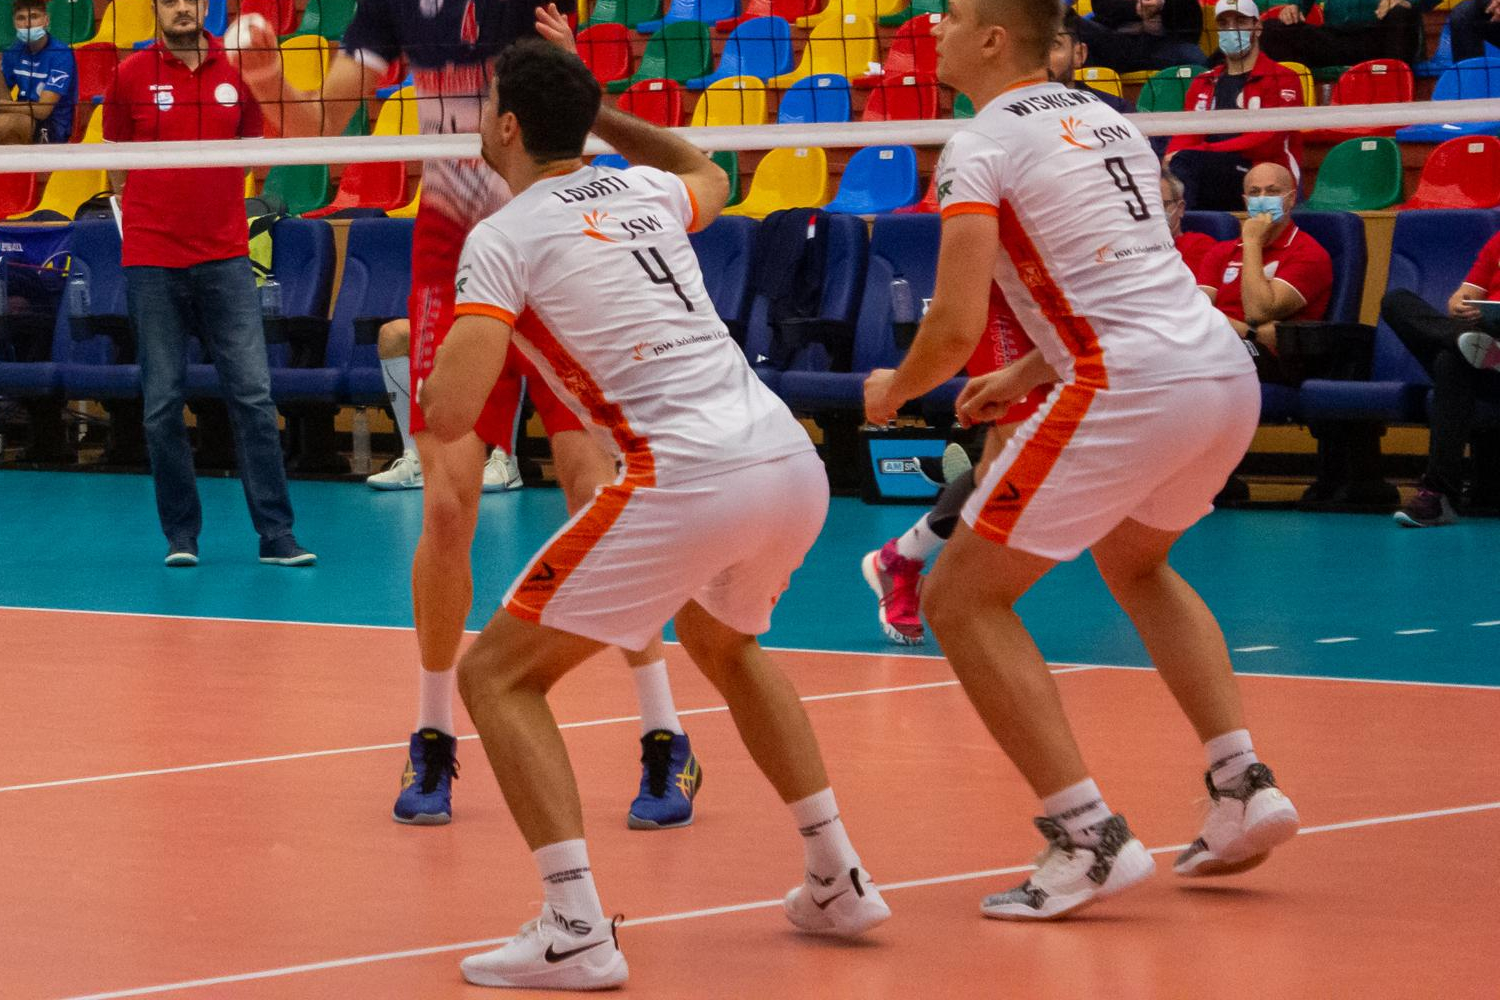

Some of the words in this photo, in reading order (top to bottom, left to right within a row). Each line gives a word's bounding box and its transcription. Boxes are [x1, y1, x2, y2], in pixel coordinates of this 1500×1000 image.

[1093, 124, 1132, 148] JSW
[1104, 156, 1151, 221] 9
[620, 214, 664, 240] JSW
[631, 246, 695, 313] 4
